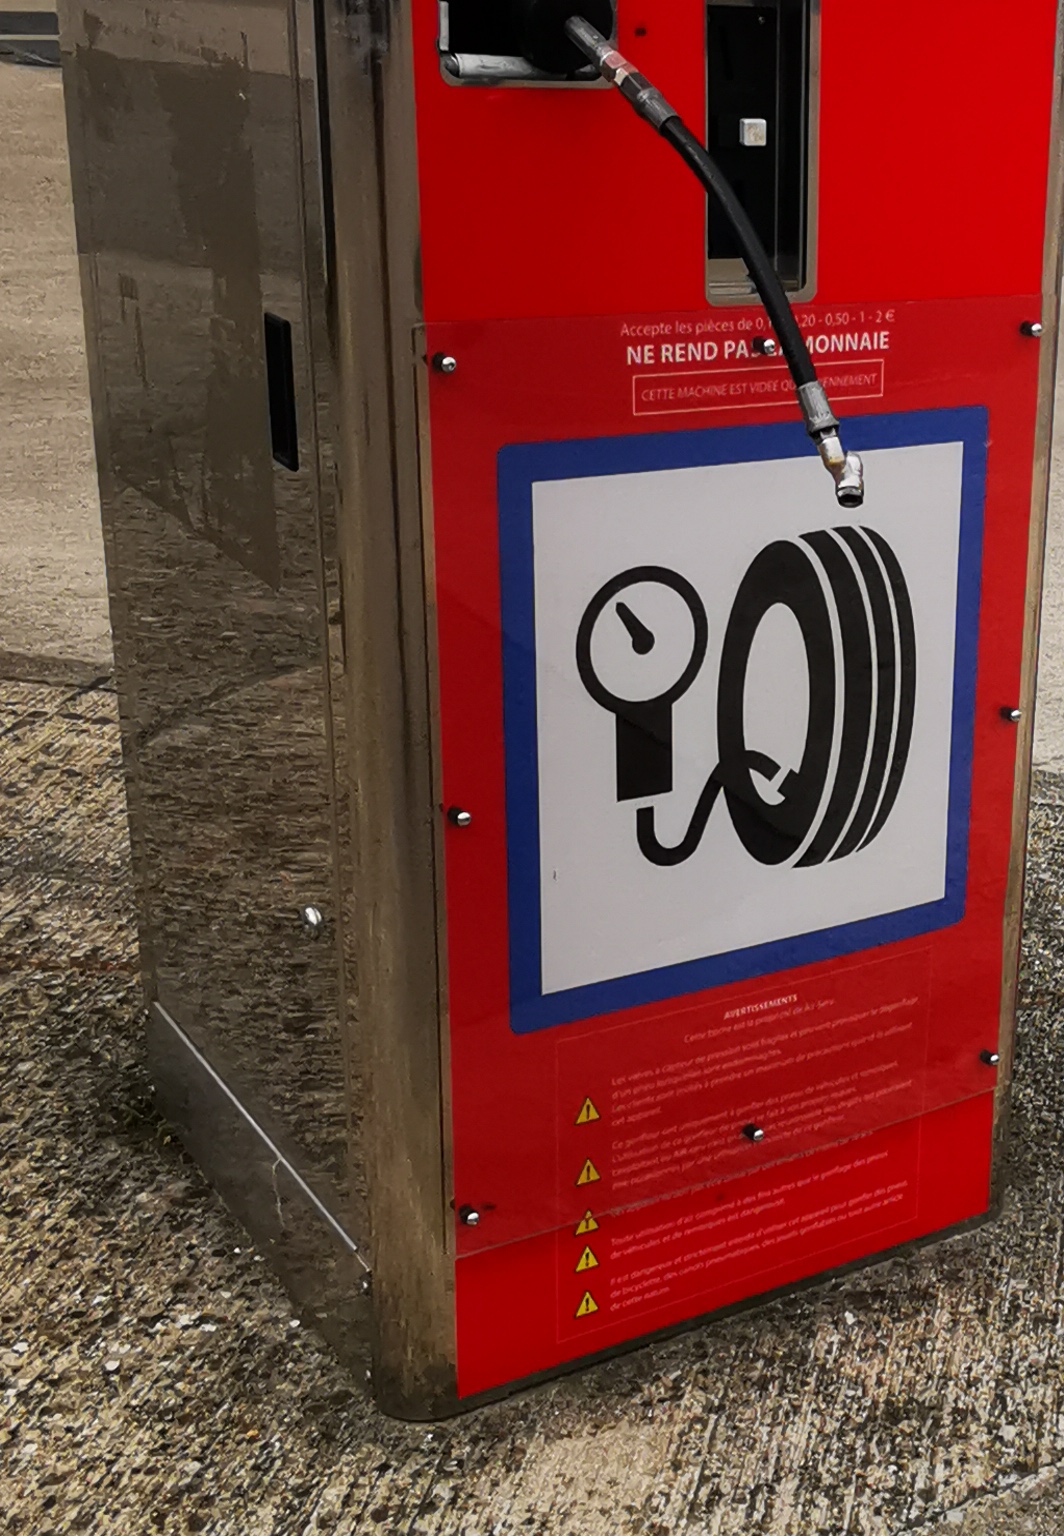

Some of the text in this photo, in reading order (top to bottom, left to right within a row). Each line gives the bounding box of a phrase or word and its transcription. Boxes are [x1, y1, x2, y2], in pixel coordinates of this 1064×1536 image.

[620, 321, 673, 338] Accepte
[675, 318, 693, 334] les
[695, 318, 735, 336] pièces
[737, 317, 753, 332] de
[825, 312, 849, 326] 0,50
[876, 310, 883, 323] 2
[885, 309, 896, 323] €
[626, 344, 655, 365] NE
[661, 341, 718, 363] REND
[724, 339, 761, 360] PA
[641, 386, 675, 402] CETTE
[677, 382, 728, 399] MACHINE
[730, 381, 748, 395] EST
[723, 994, 798, 1020] AVERTISSEMENTS
